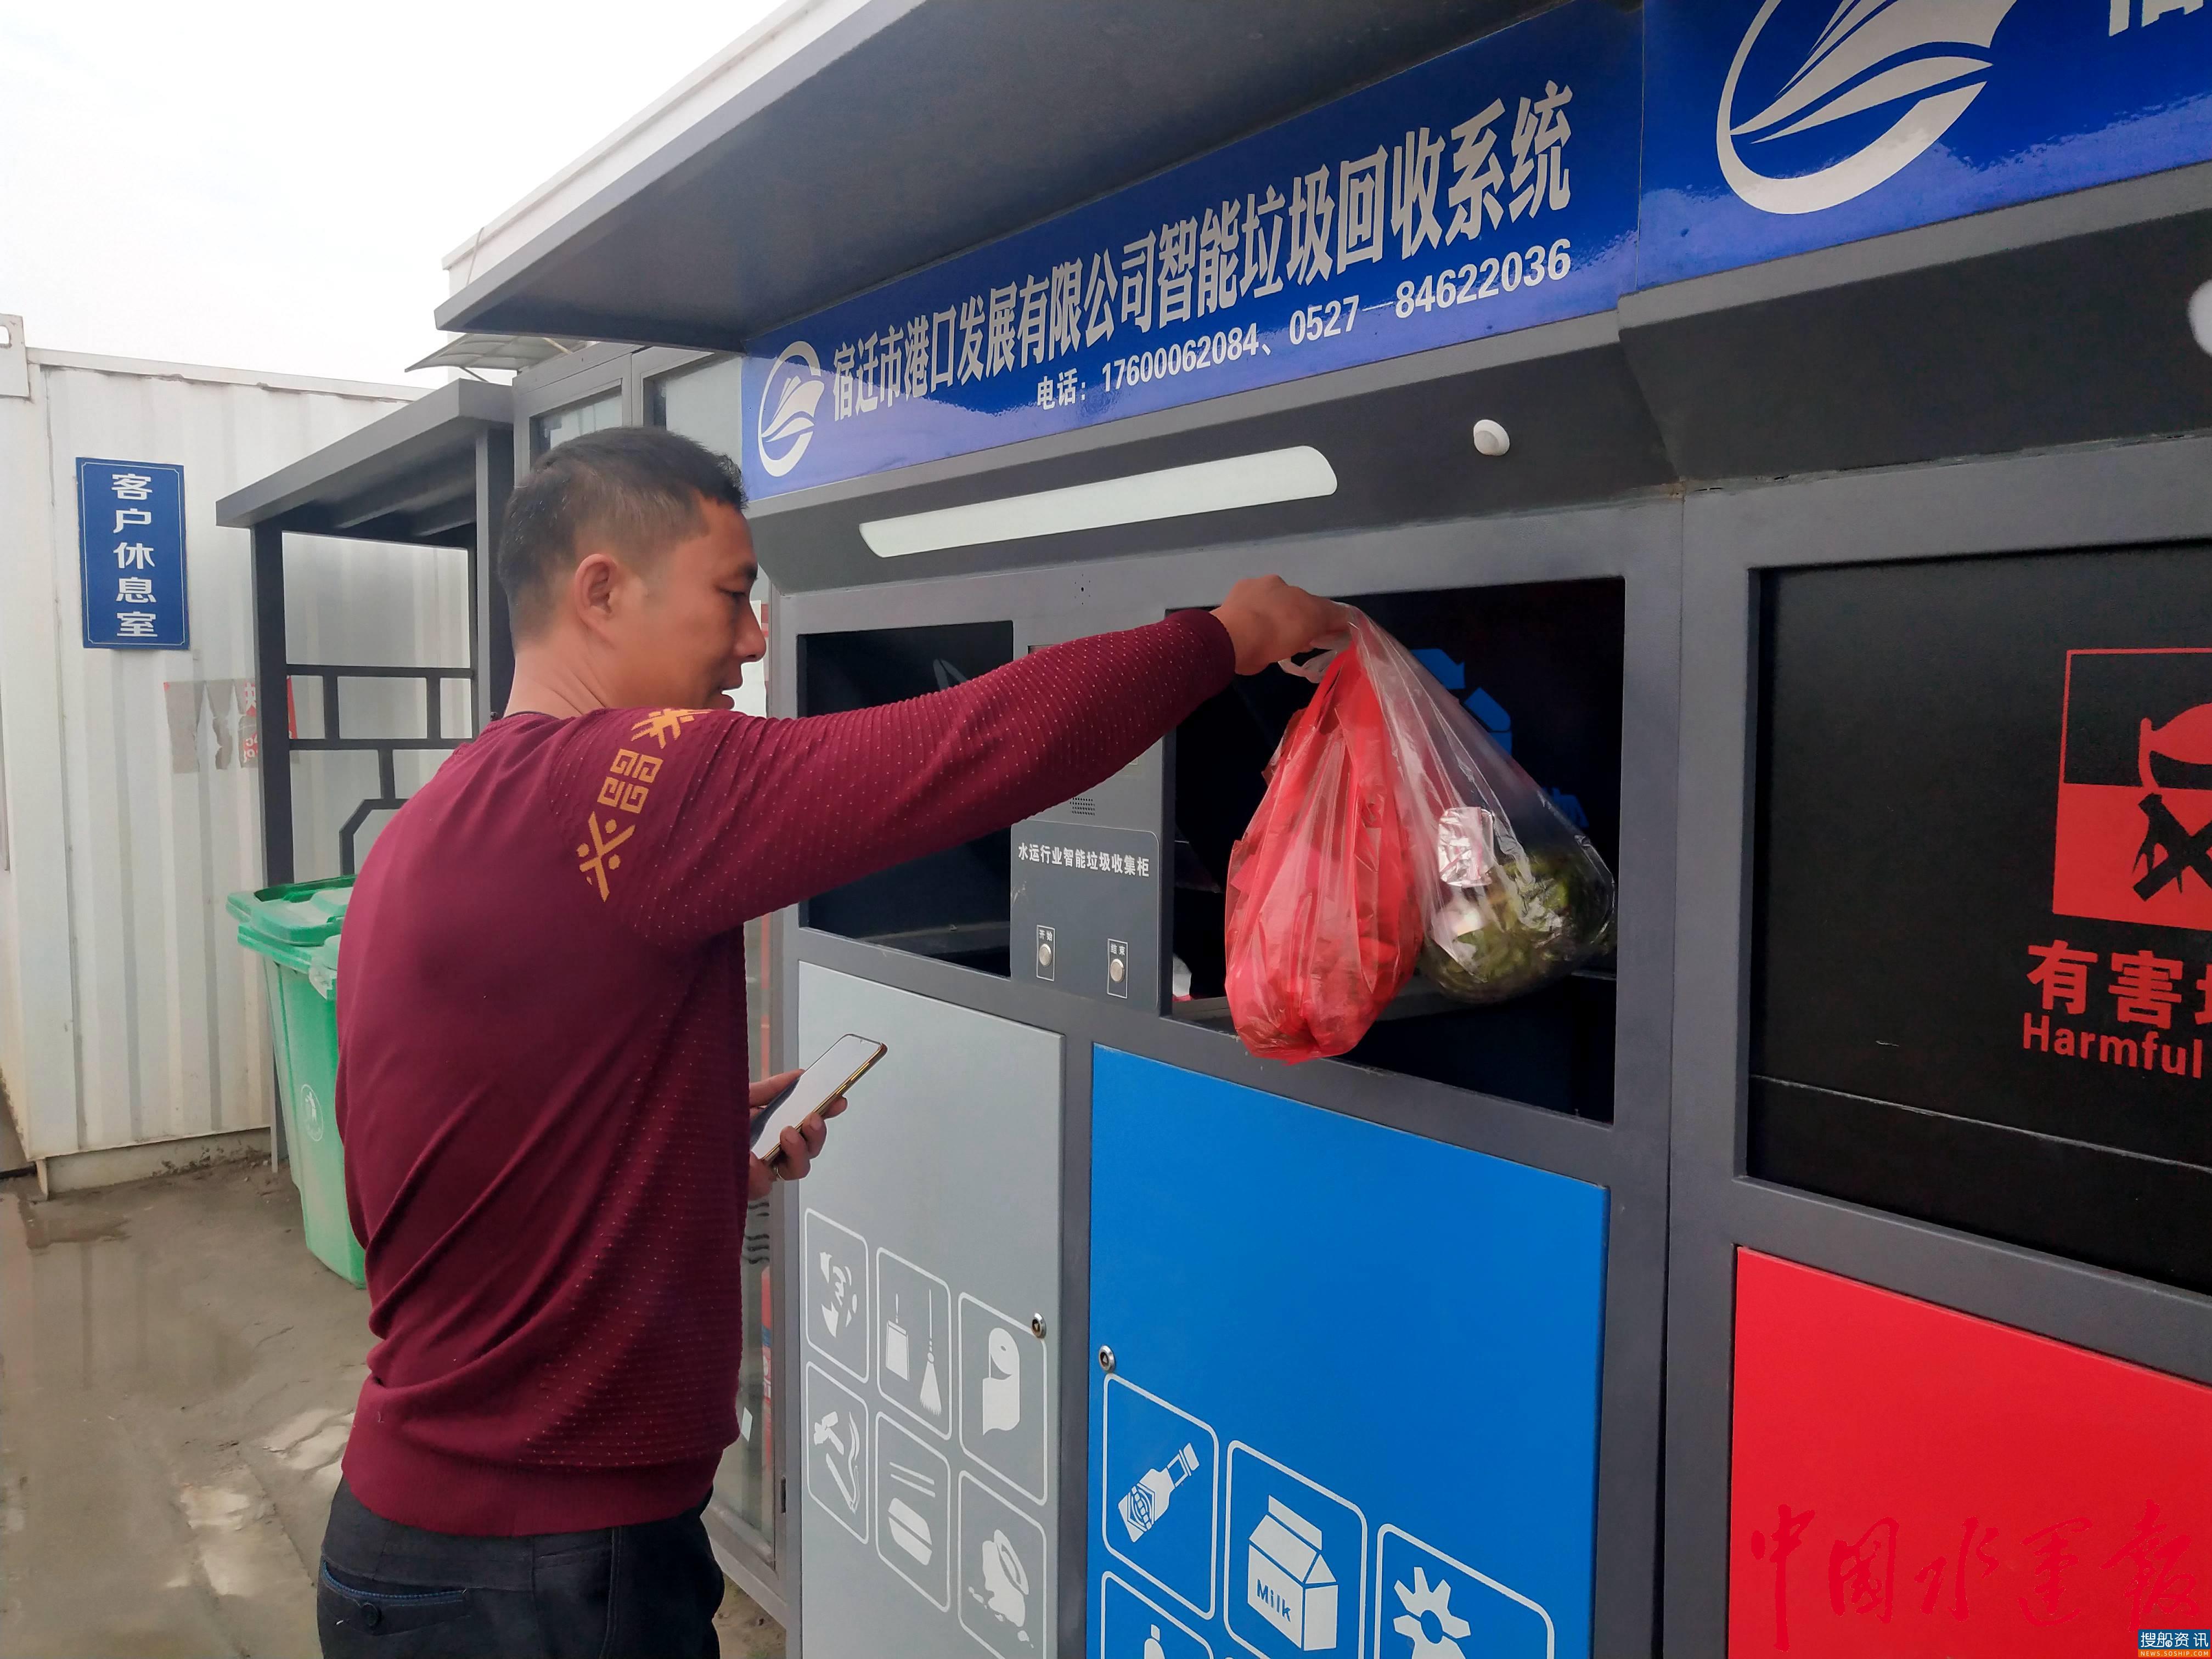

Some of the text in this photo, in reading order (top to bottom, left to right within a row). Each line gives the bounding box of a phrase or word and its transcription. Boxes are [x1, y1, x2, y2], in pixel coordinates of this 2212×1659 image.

[832, 80, 1573, 421] 宿迁市港口发展有限公司智能垃圾回收系统
[111, 473, 158, 637] 客户休息室
[1018, 842, 1150, 877] 水运行业智能垃圾收集柜
[1039, 929, 1053, 942] 开始
[1110, 943, 1125, 956] 结束
[2023, 1012, 2202, 1079] Harmful
[1257, 1579, 1291, 1622] Milk
